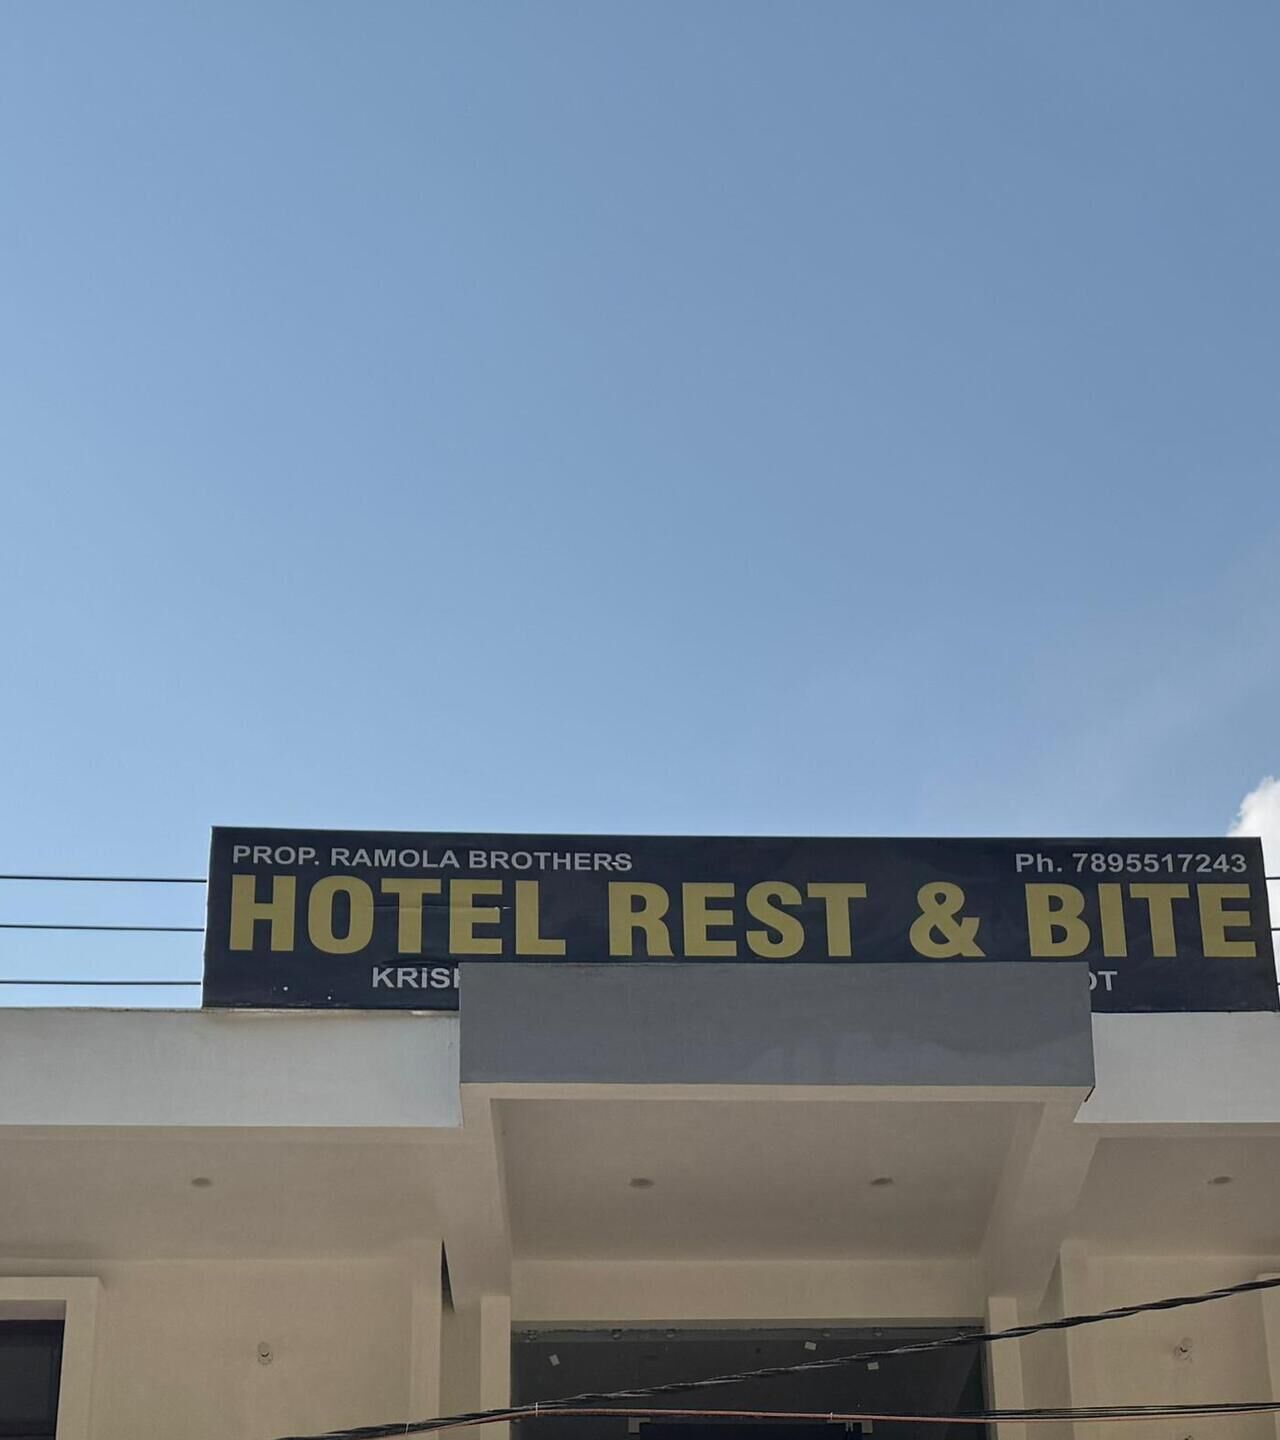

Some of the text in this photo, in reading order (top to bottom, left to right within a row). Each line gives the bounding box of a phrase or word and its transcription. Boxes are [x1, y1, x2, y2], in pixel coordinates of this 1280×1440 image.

[234, 846, 633, 871] PROP. RAMOLA BROTHERS
[1016, 854, 1247, 872] Ph. 7895517243
[230, 875, 1257, 958] HOTEL REST & BITE
[372, 967, 460, 989] KRIS
